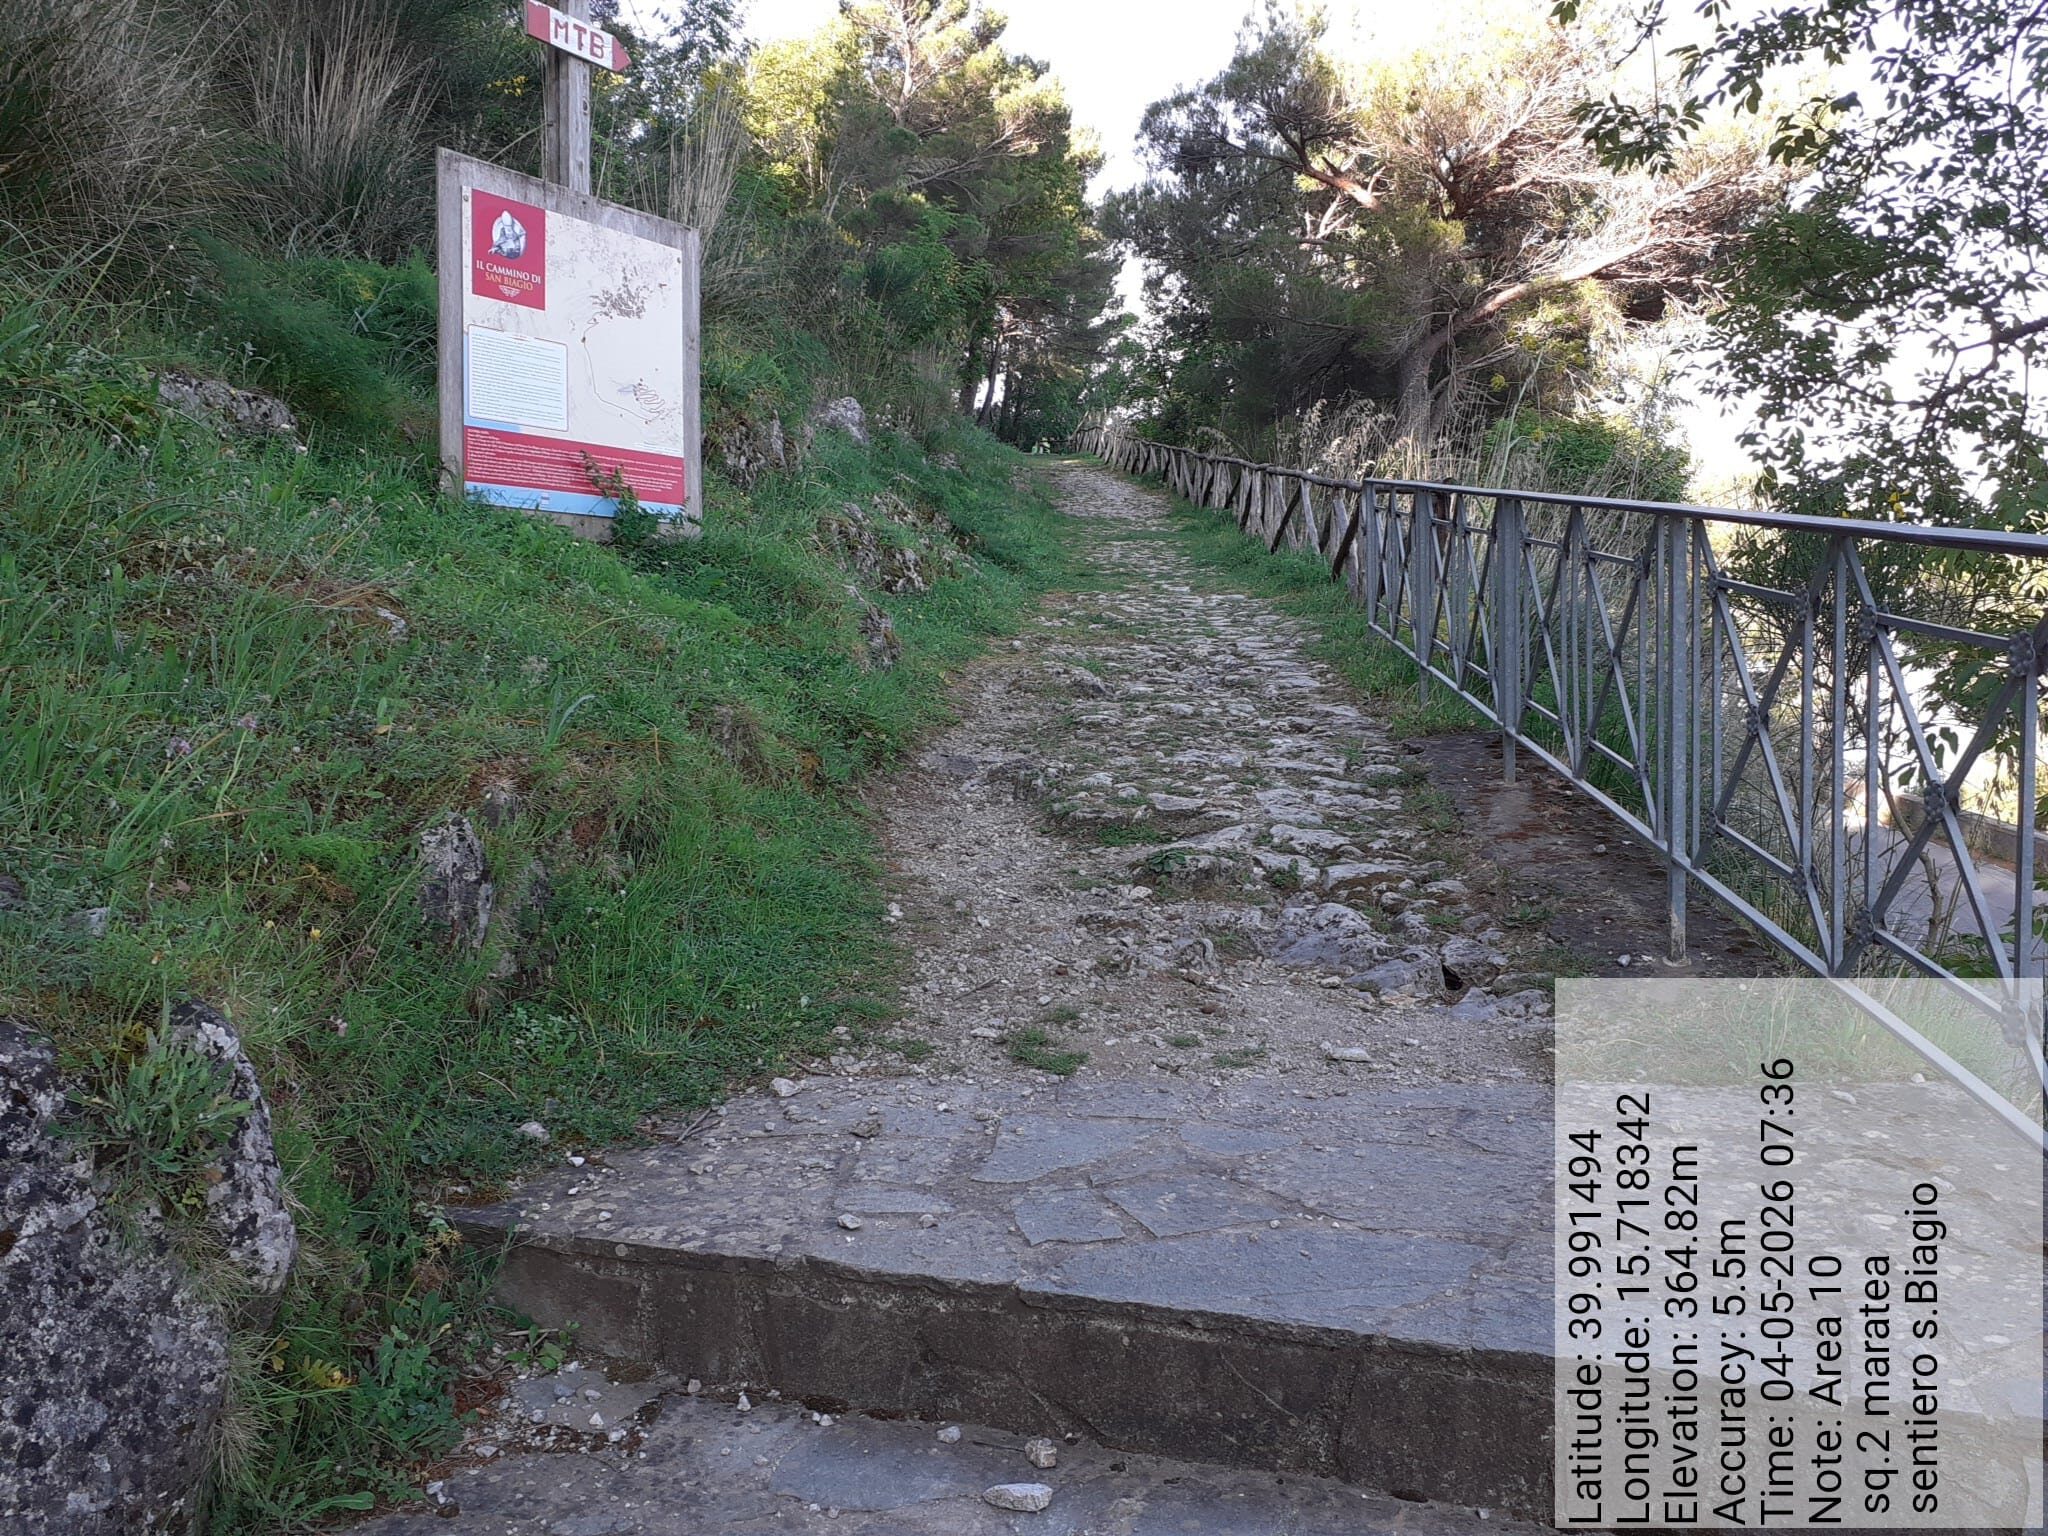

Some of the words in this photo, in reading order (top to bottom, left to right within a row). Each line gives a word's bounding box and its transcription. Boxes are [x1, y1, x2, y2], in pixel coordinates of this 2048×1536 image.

[554, 18, 605, 59] MTB
[476, 259, 485, 270] IL
[486, 262, 530, 281] CAMMINO
[531, 273, 541, 285] DI
[485, 271, 502, 283] SAN
[504, 276, 533, 291] BIAGIO
